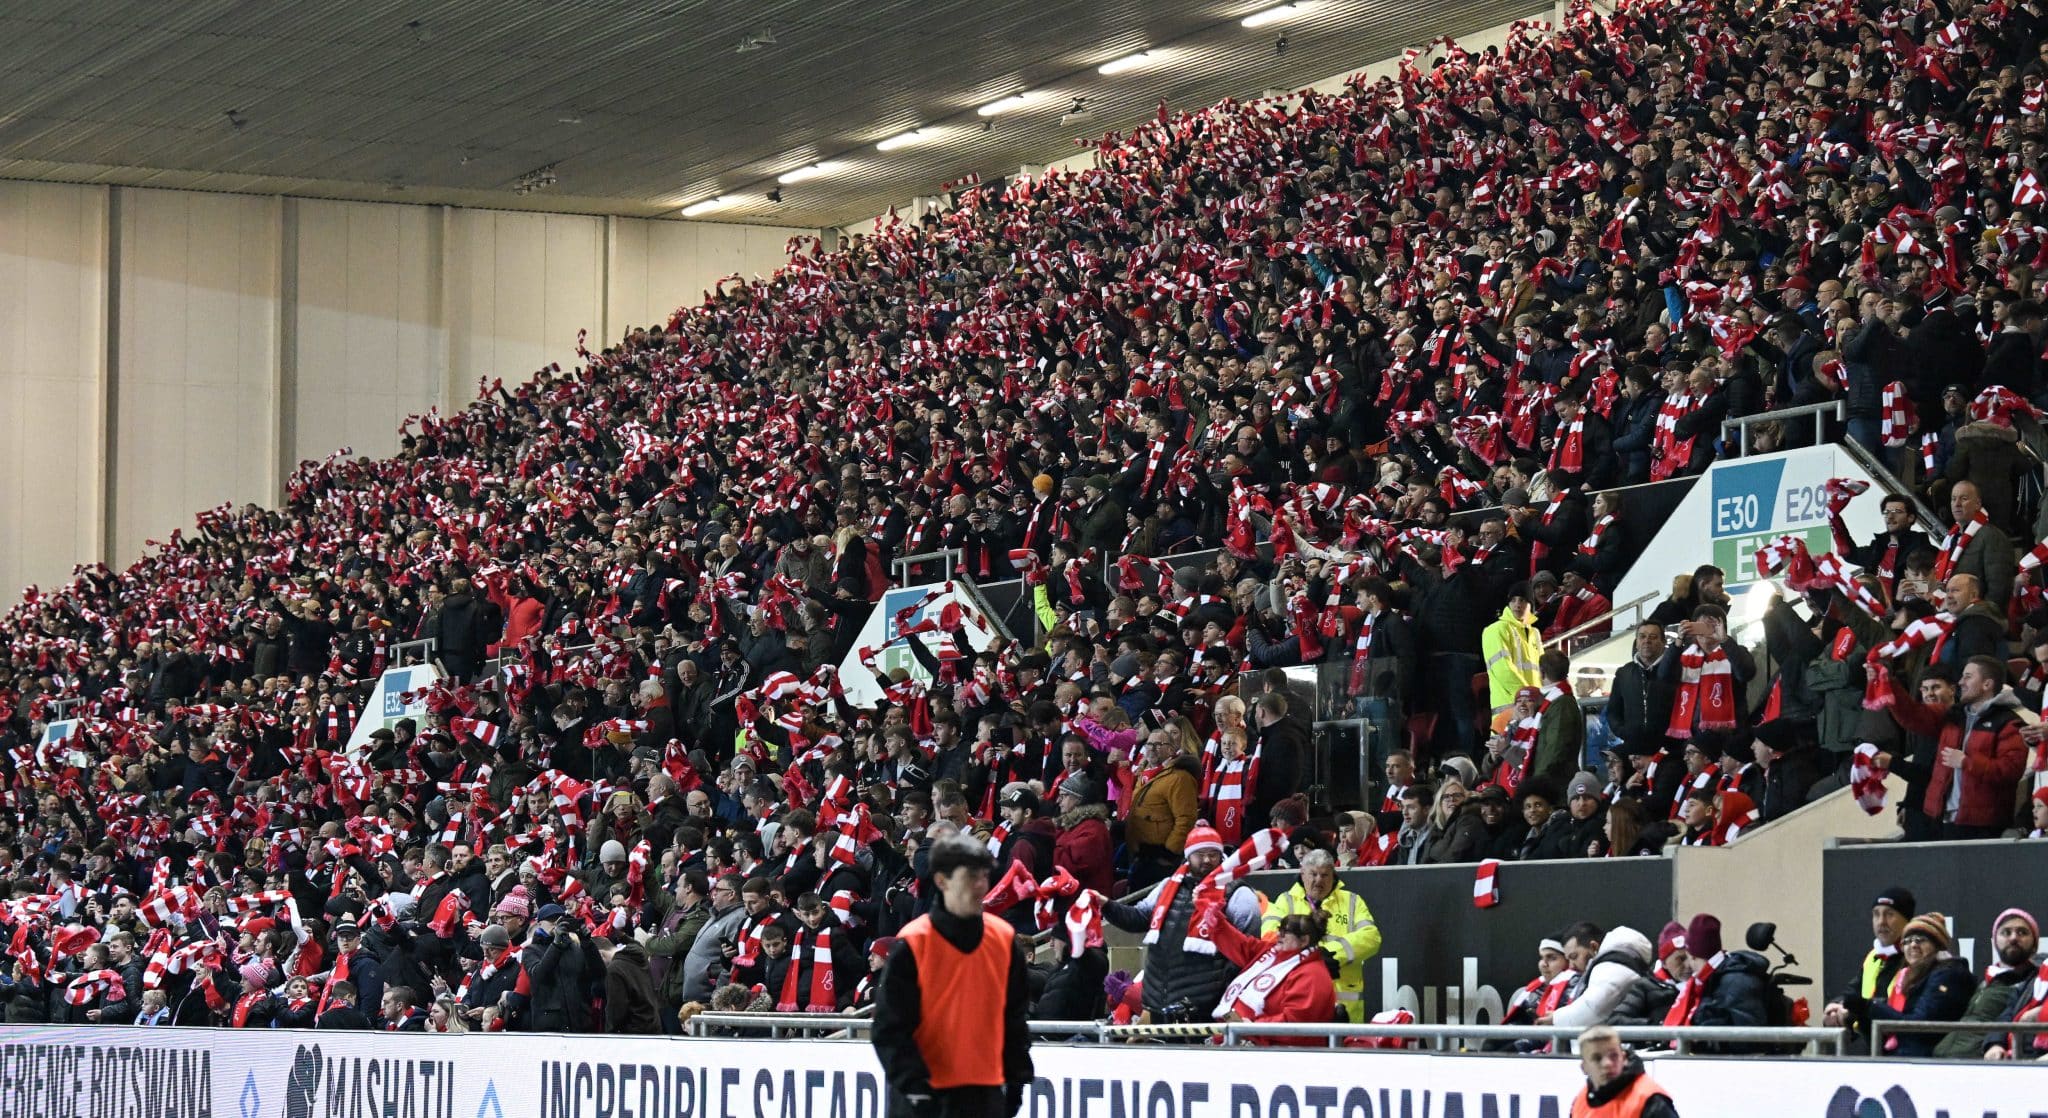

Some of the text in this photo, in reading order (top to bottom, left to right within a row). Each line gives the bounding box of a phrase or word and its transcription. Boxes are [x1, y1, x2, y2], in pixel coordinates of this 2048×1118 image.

[1717, 493, 1759, 533] E30
[1785, 484, 1828, 523] E29
[385, 689, 401, 714] E32
[90, 1045, 212, 1118] BOTSWANA
